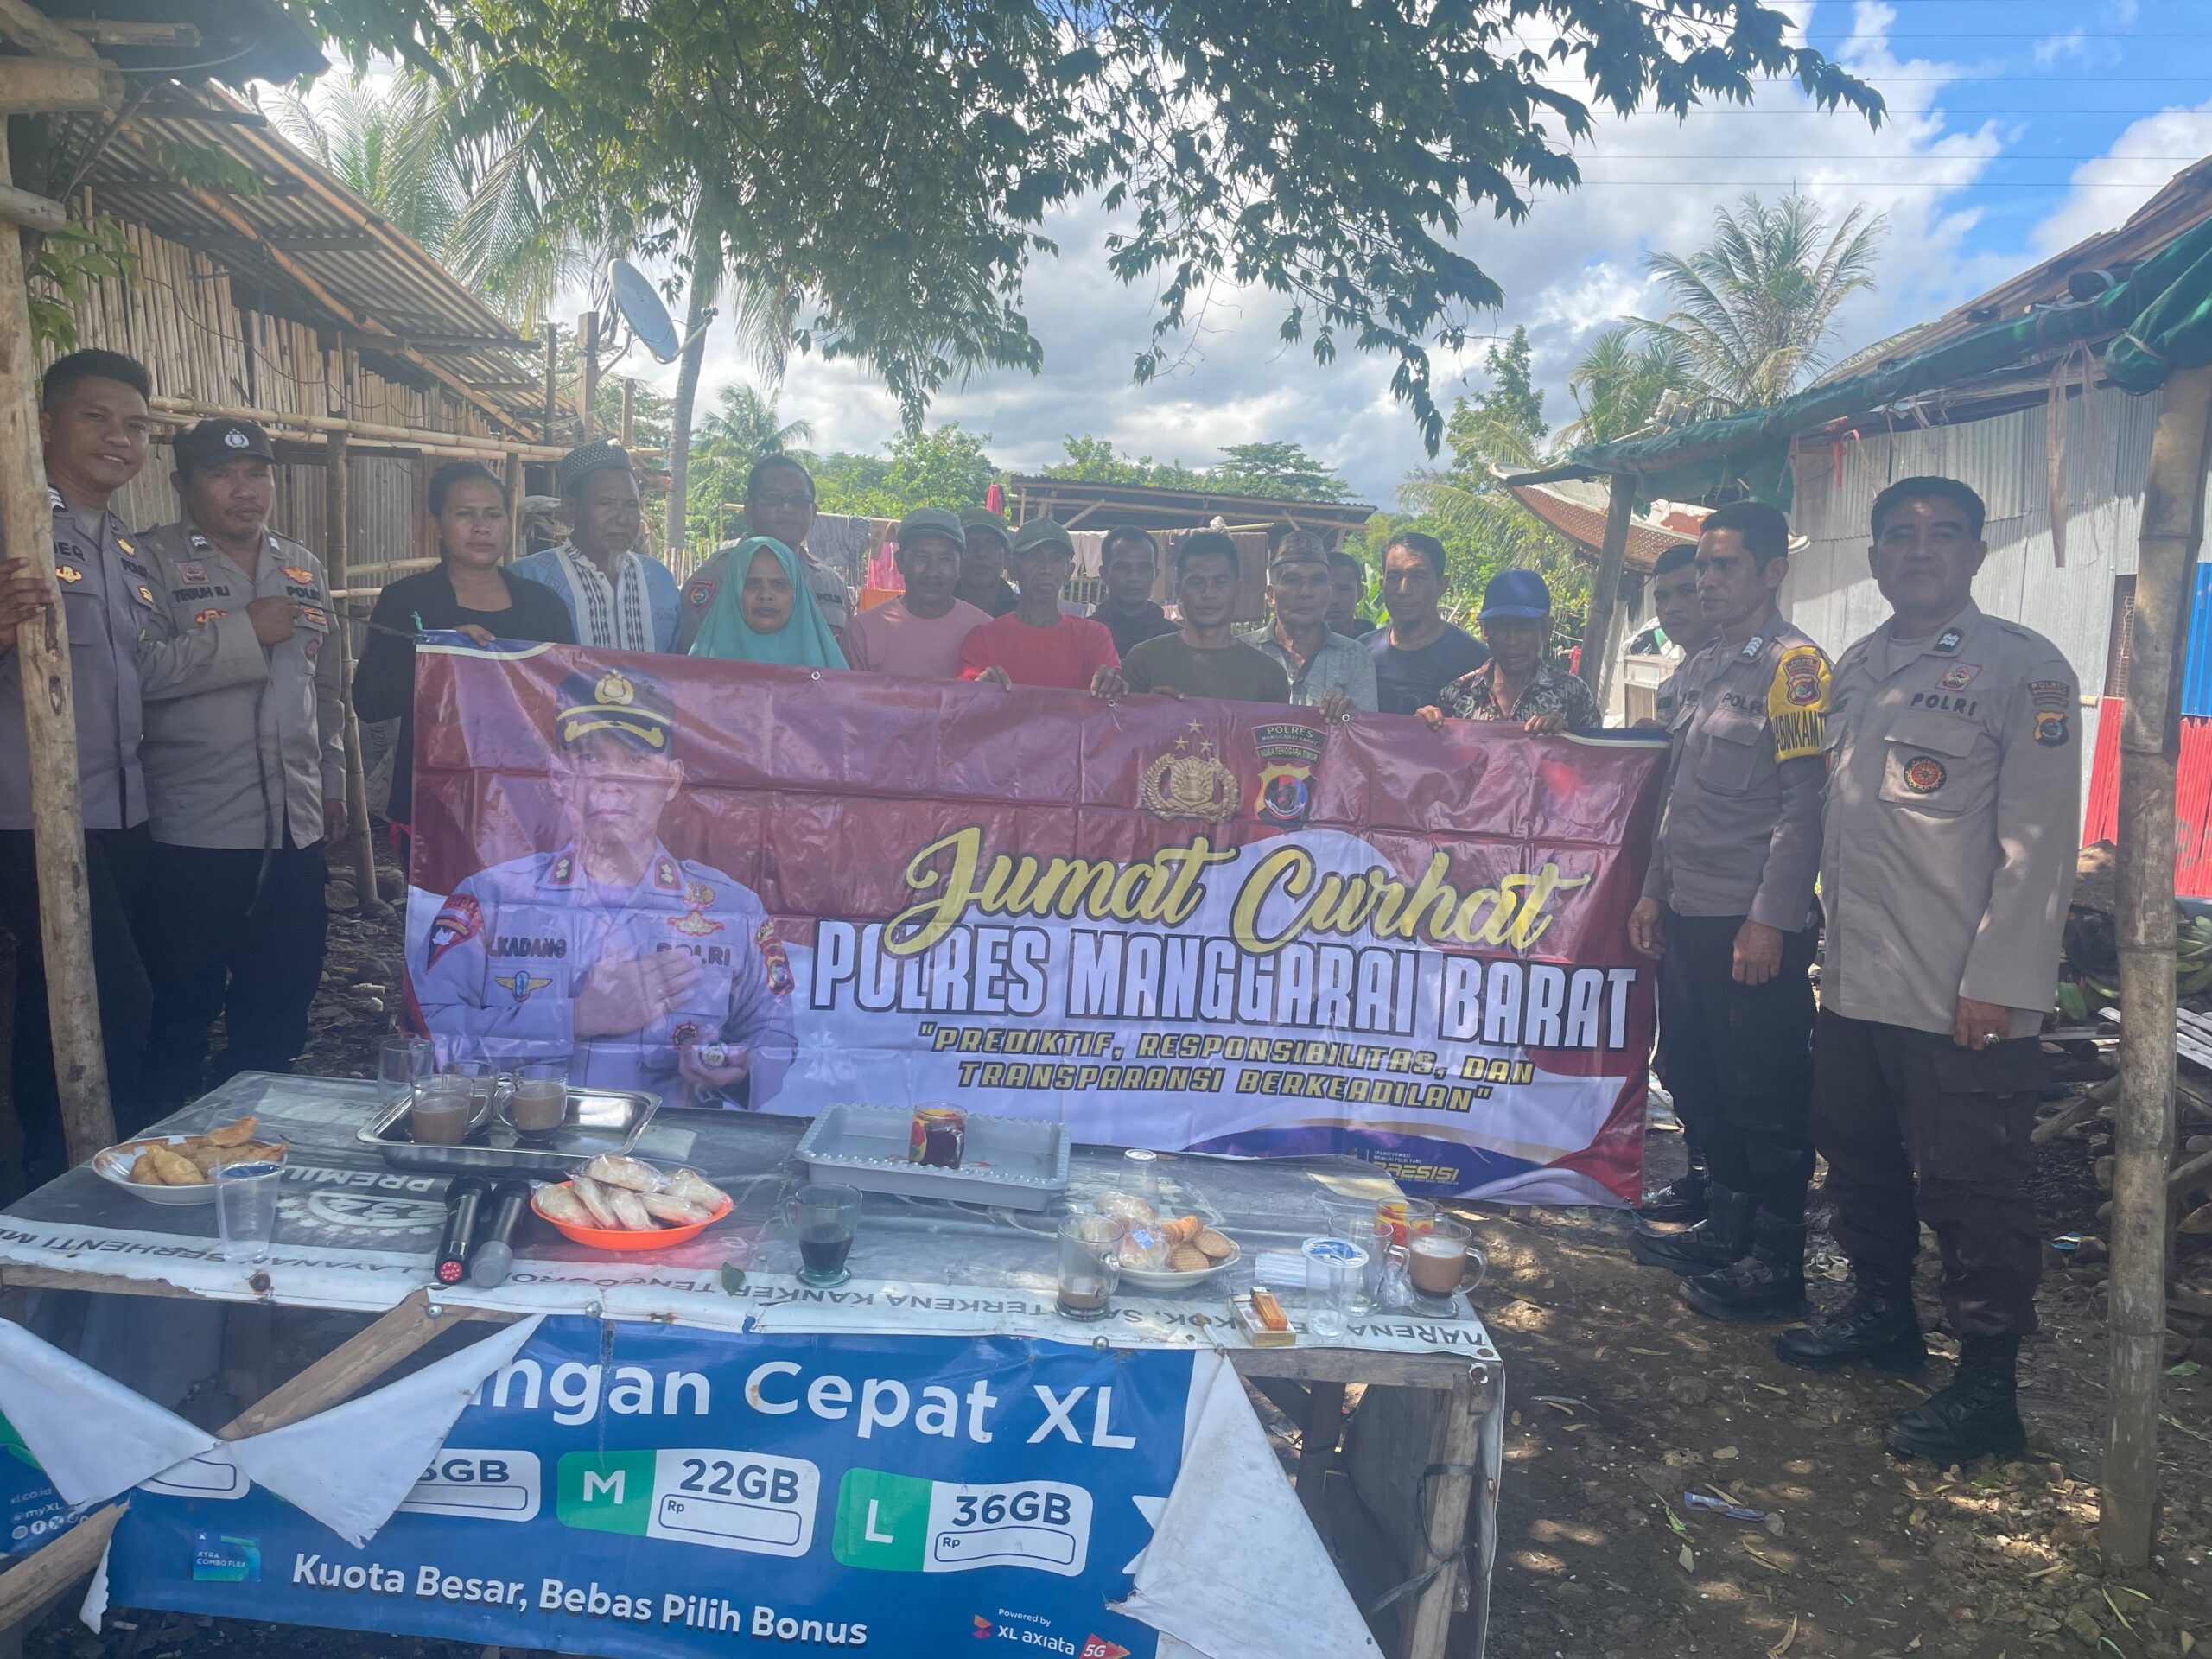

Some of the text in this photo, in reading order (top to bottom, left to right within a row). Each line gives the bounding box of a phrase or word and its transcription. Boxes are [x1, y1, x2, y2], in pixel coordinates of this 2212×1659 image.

[1910, 692, 1977, 717] POLRI
[1266, 726, 1314, 738] POLRES
[883, 826, 1592, 955] Jumat Curhat
[810, 918, 1640, 1053] POLRES MANGGARAI BARAT
[919, 1021, 1535, 1086] "PREDIKTIF, RESPONSIBILITAS, DAN
[958, 1061, 1494, 1114] TRANSPARANSI BERKEADILAN"
[883, 1293, 1046, 1316] TERKENA
[468, 1358, 1137, 1450] ngan Cepat XL
[582, 1458, 799, 1505] M 22GB
[666, 1499, 686, 1516] Rp
[863, 1490, 1071, 1544] L 36GB
[196, 1558, 226, 1567] COMBO
[942, 1536, 961, 1551] Rp
[292, 1553, 868, 1645] Kuota Besar, Bebas Pilih Bonus
[997, 1607, 1052, 1628] Powered by
[996, 1624, 1108, 1658] XL axiata 5G
